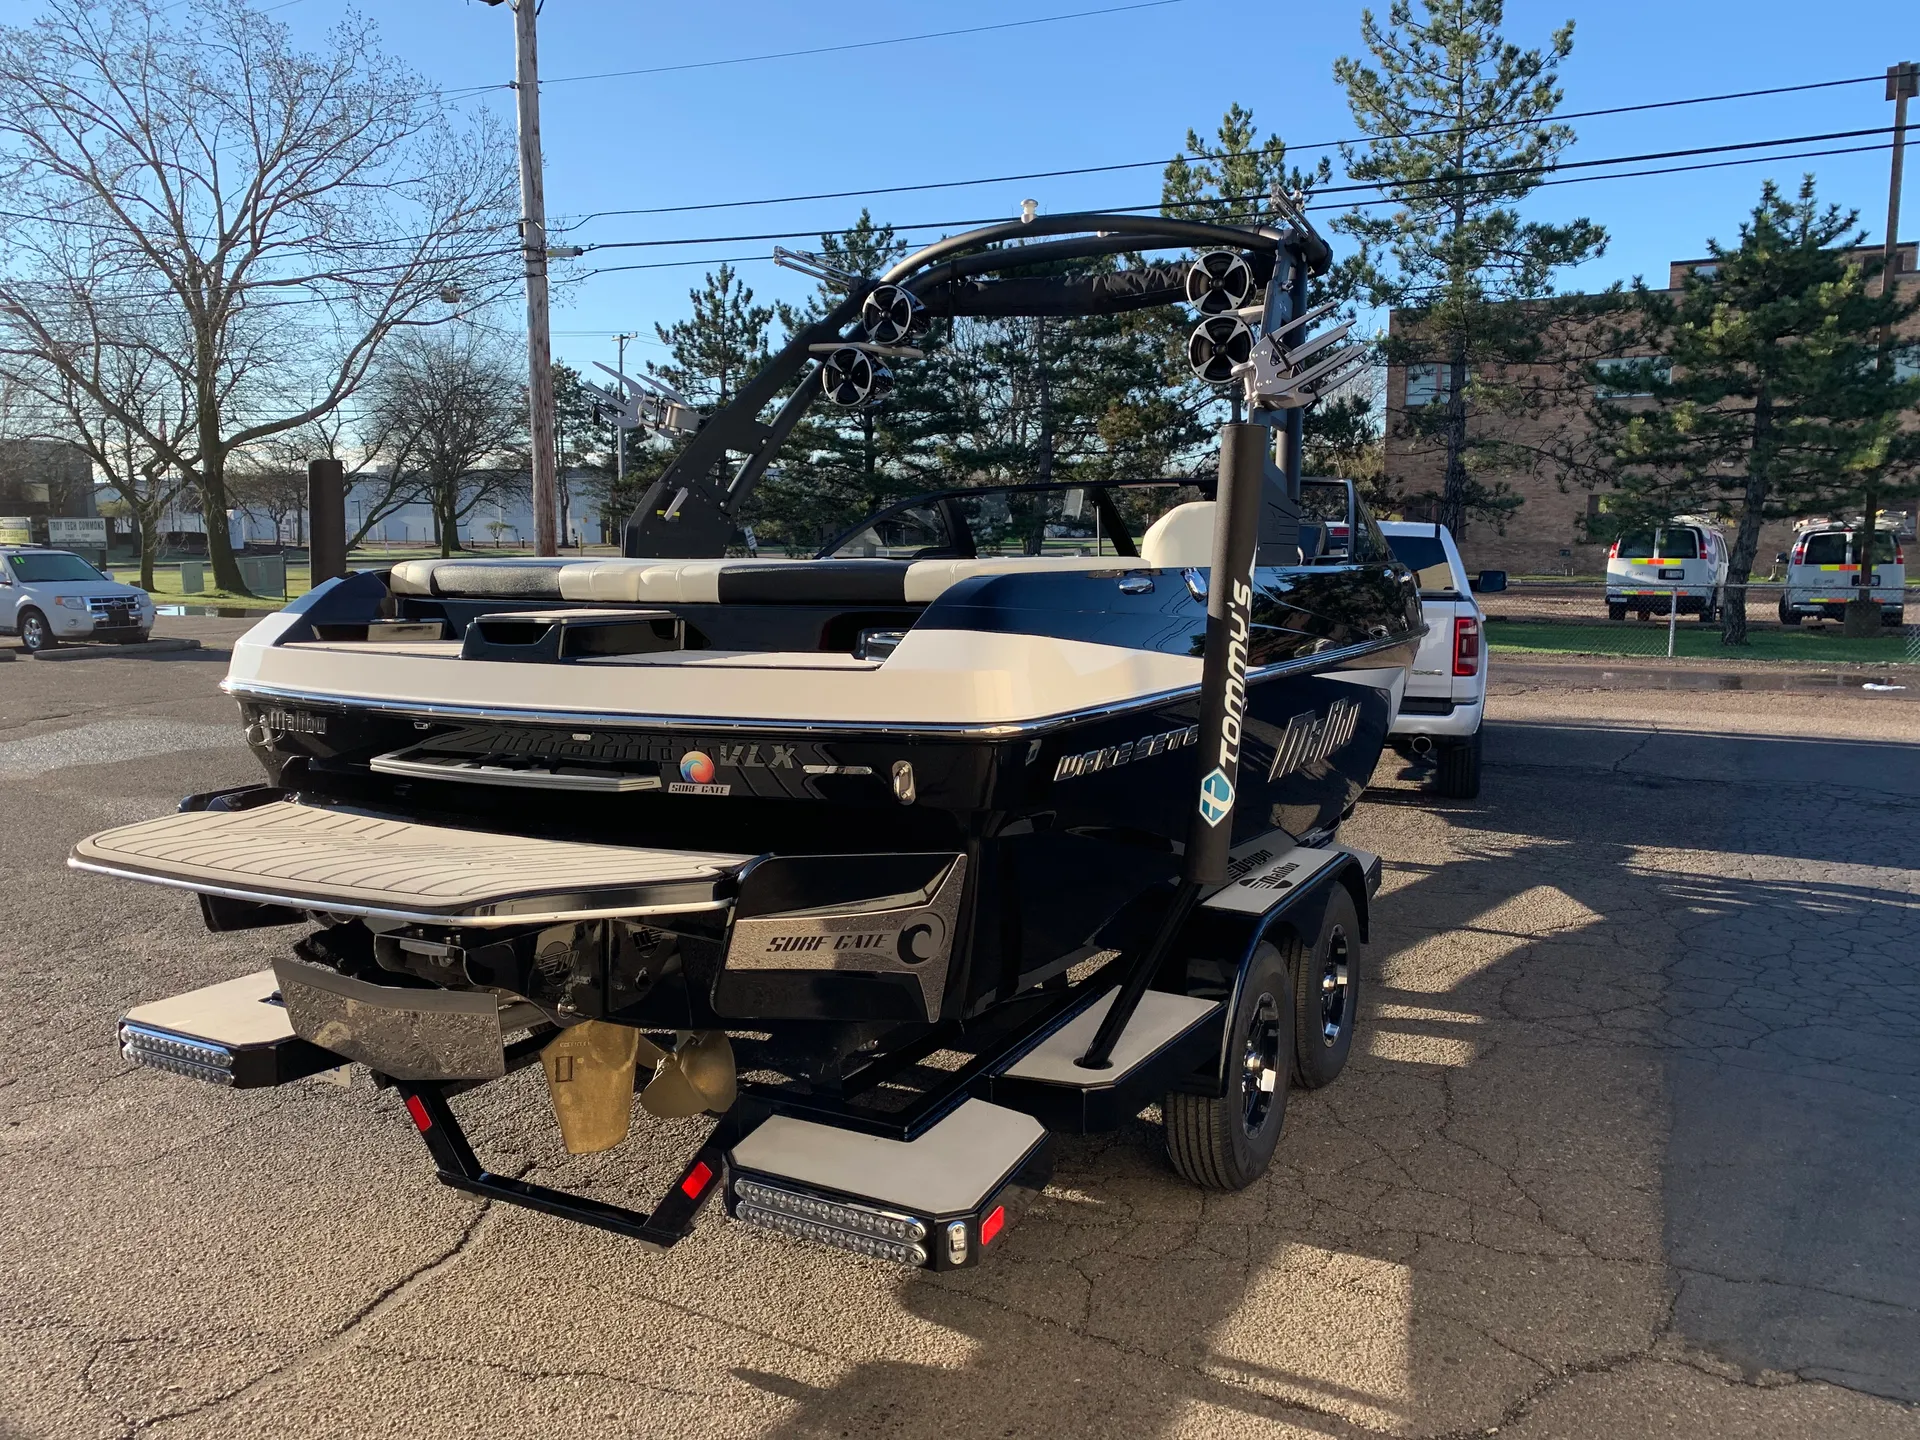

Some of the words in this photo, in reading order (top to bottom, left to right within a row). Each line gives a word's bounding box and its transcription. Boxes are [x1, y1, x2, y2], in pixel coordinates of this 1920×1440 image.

[79, 521, 105, 531] COMMONS
[269, 708, 327, 735] Malibu
[719, 742, 796, 769] VLX
[671, 784, 698, 793] SURF
[701, 785, 727, 795] GATE
[1260, 862, 1300, 885] Malibu
[766, 936, 831, 952] SURF
[833, 933, 891, 950] GATE
